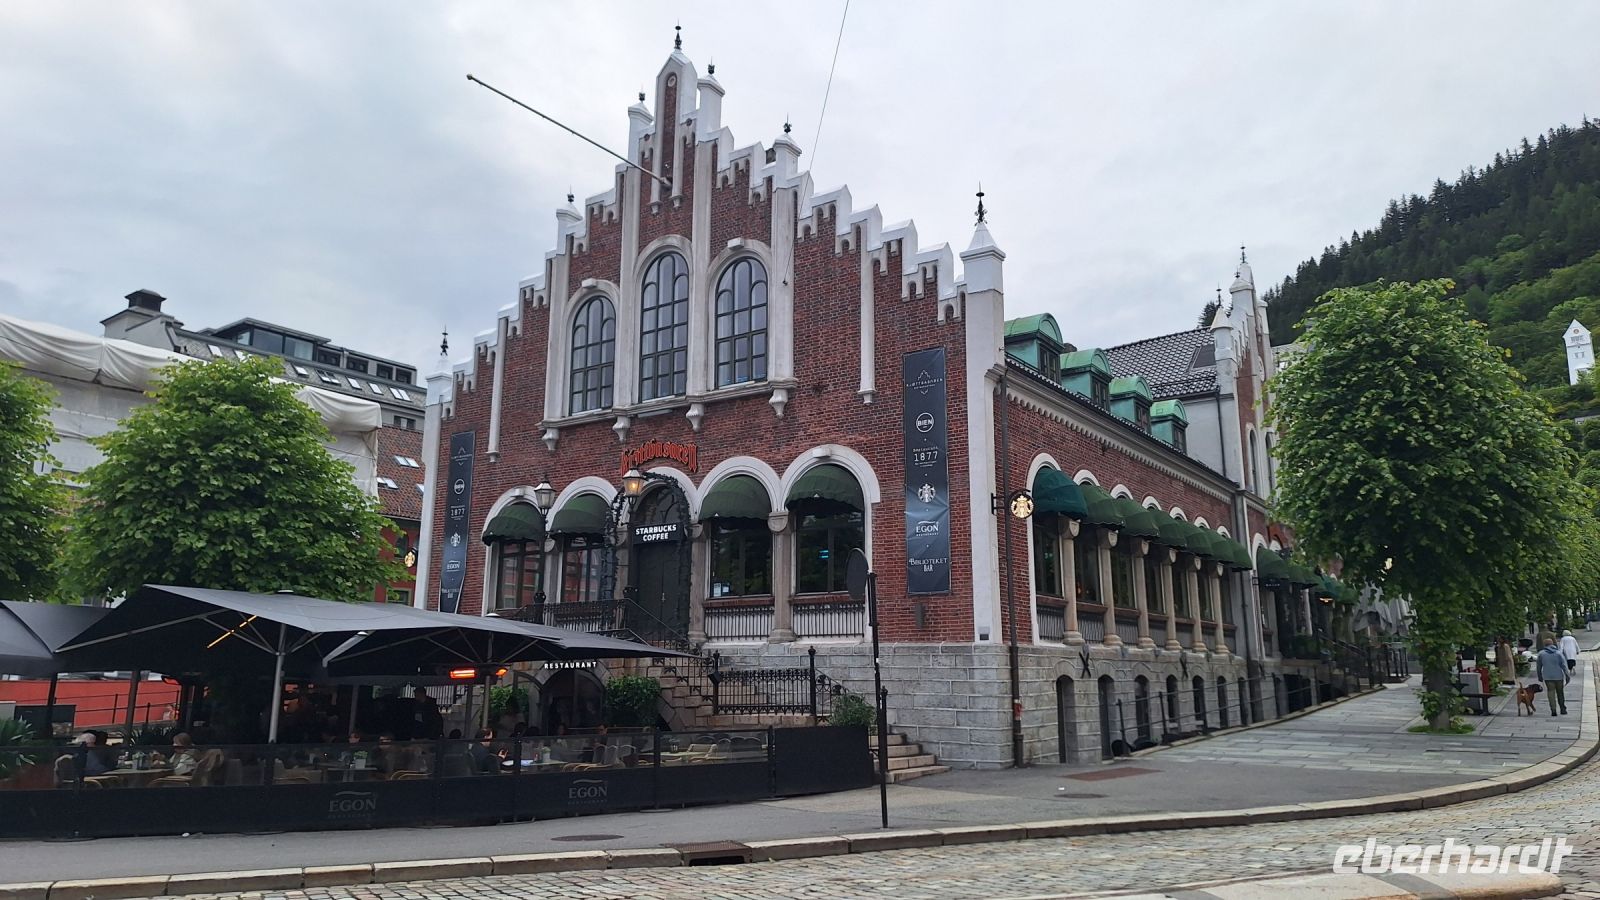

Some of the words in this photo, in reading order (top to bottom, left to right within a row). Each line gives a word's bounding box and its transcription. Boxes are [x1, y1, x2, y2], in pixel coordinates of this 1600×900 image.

[917, 419, 933, 427] BIEN
[914, 451, 938, 462] 1877
[450, 508, 465, 516] 1877
[636, 524, 677, 536] STARBUCKS
[916, 524, 939, 533] EGON
[643, 532, 669, 542] COFFEE
[544, 661, 597, 669] RESTAURANT
[568, 786, 608, 799] EGON
[328, 799, 377, 812] EGON
